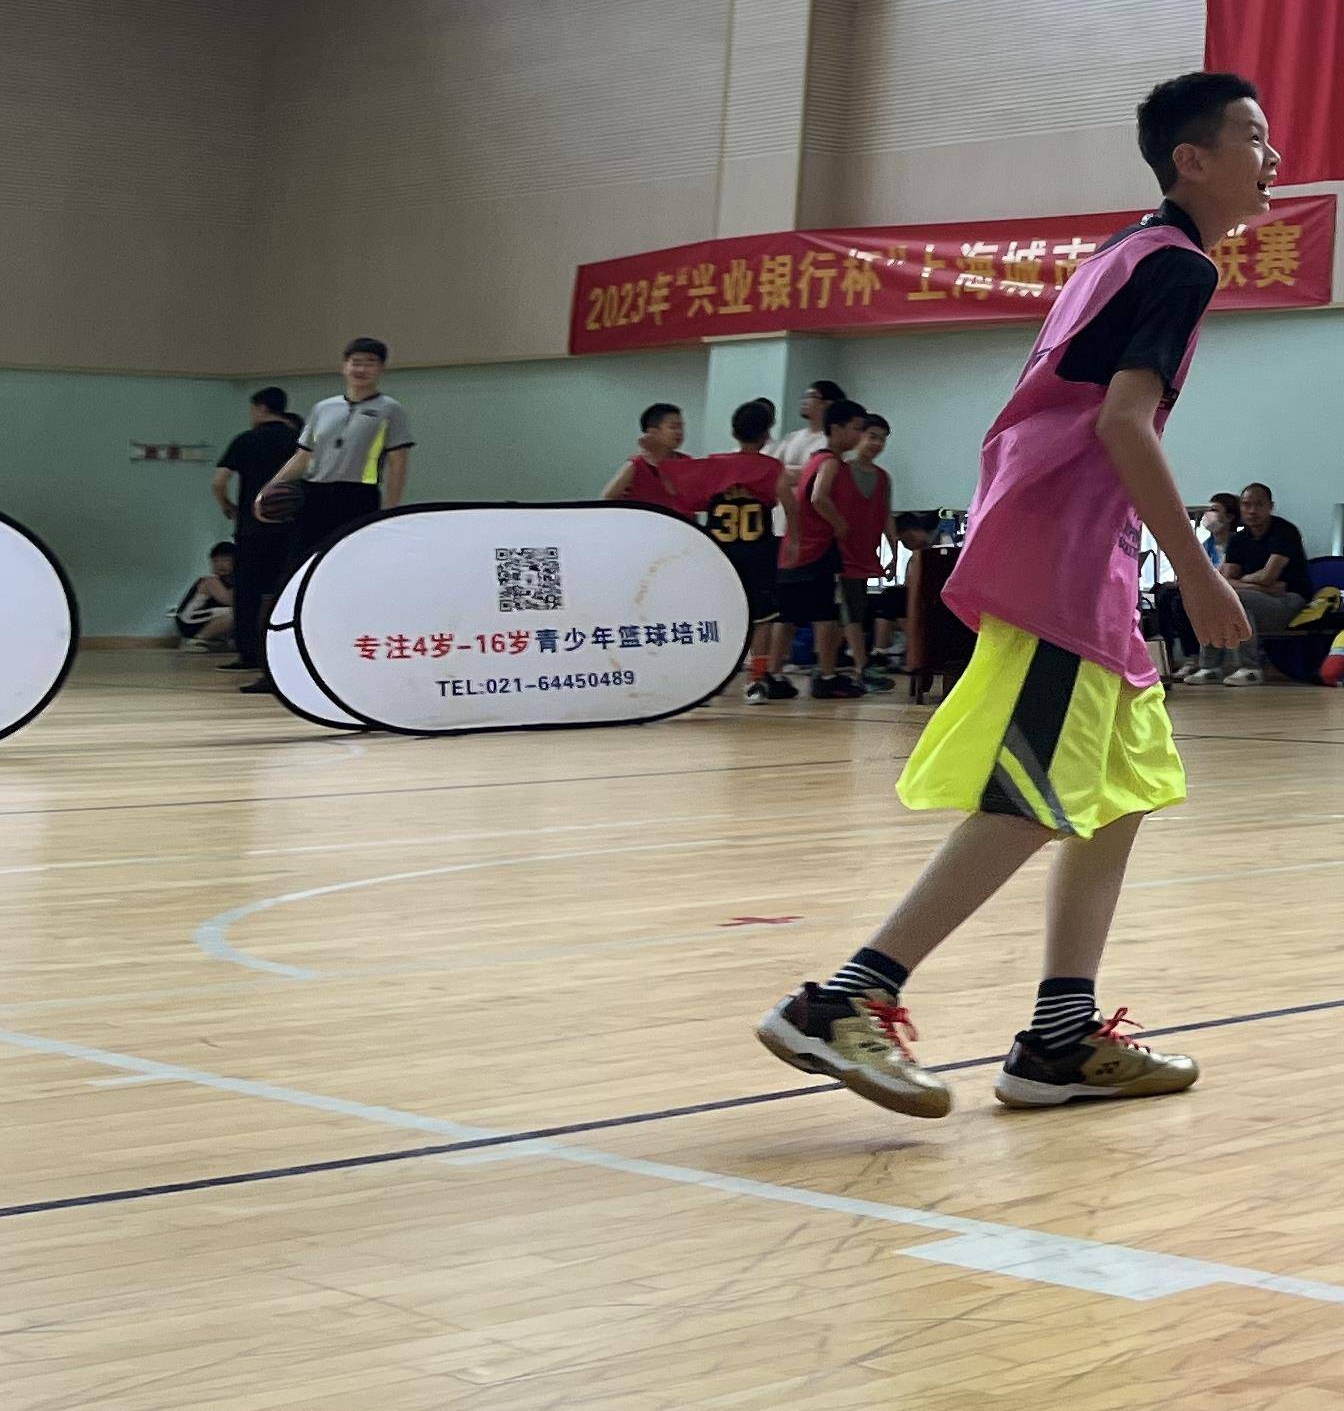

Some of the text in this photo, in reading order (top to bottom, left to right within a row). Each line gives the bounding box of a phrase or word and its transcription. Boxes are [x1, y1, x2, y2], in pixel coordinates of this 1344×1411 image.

[710, 503, 765, 542] 30
[354, 620, 721, 661] 专注4岁-16岁青少年篮球培训
[437, 669, 636, 698] TEL:021-64450489
